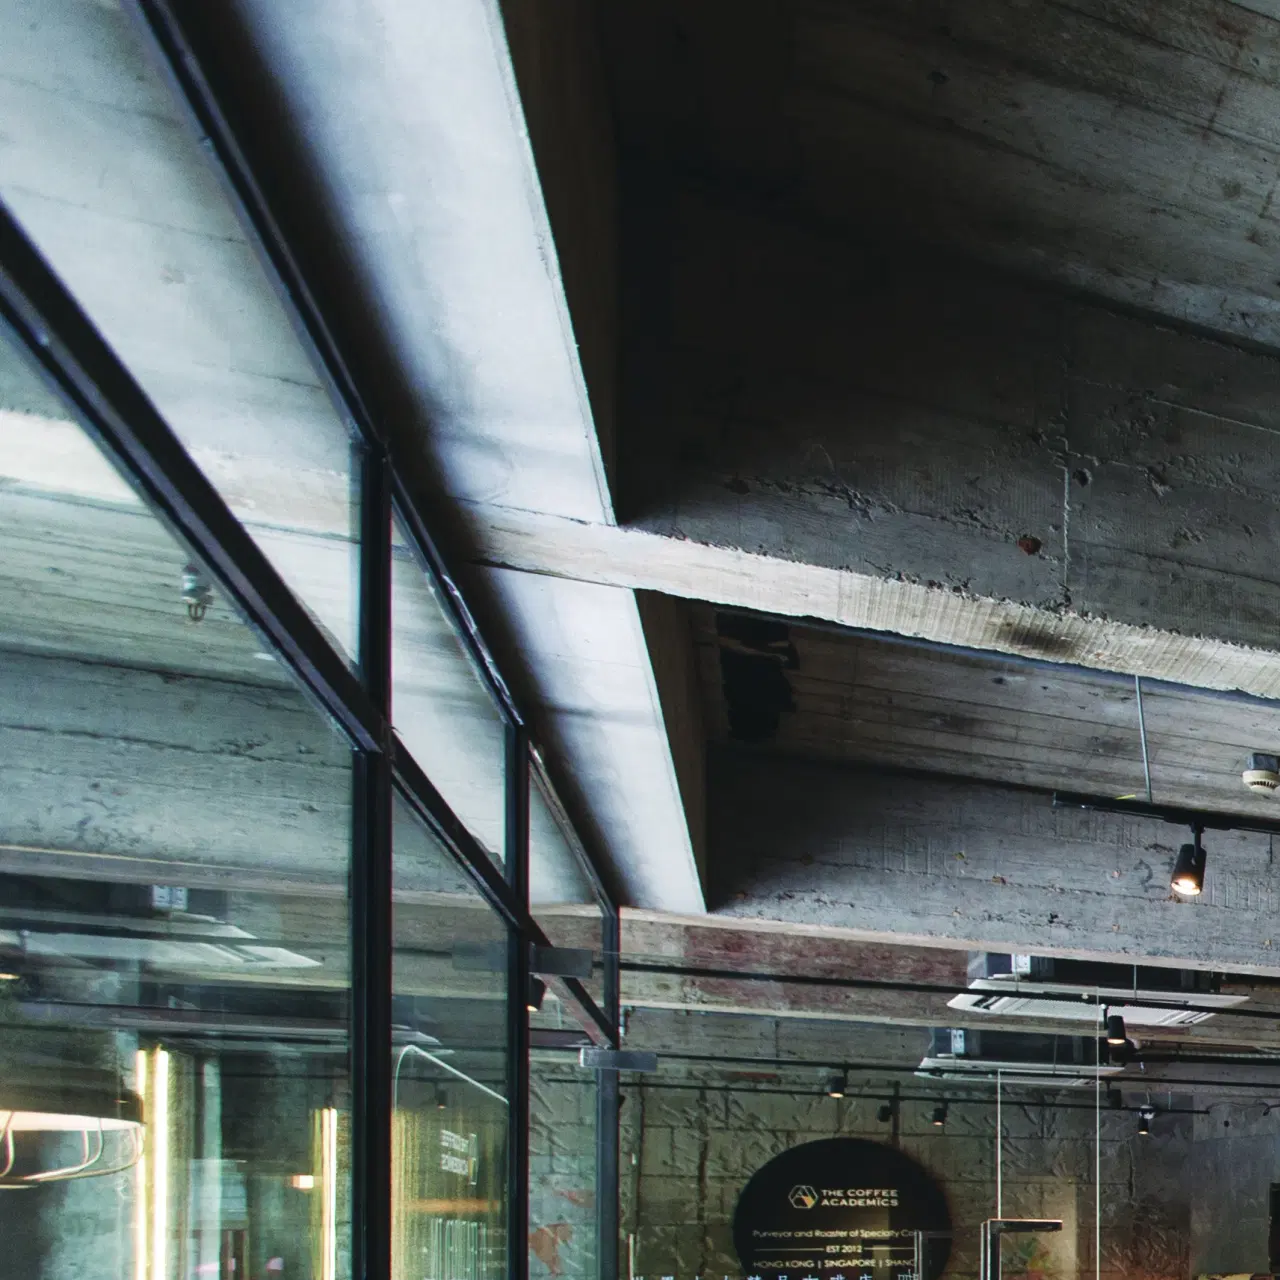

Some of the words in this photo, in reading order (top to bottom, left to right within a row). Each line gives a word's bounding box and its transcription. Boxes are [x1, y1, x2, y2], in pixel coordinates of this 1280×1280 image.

[821, 1188, 844, 1197] THE
[847, 1188, 898, 1197] COFFEE
[753, 1230, 792, 1239] Purveyor
[794, 1230, 813, 1238] and
[814, 1229, 848, 1238] Roaster
[850, 1229, 859, 1238] of
[860, 1228, 899, 1239] Specialty
[825, 1245, 840, 1254] EST
[841, 1245, 862, 1254] 2012
[753, 1260, 783, 1269] HONG
[785, 1260, 814, 1268] KONG
[823, 1259, 876, 1268] SINGAPORE
